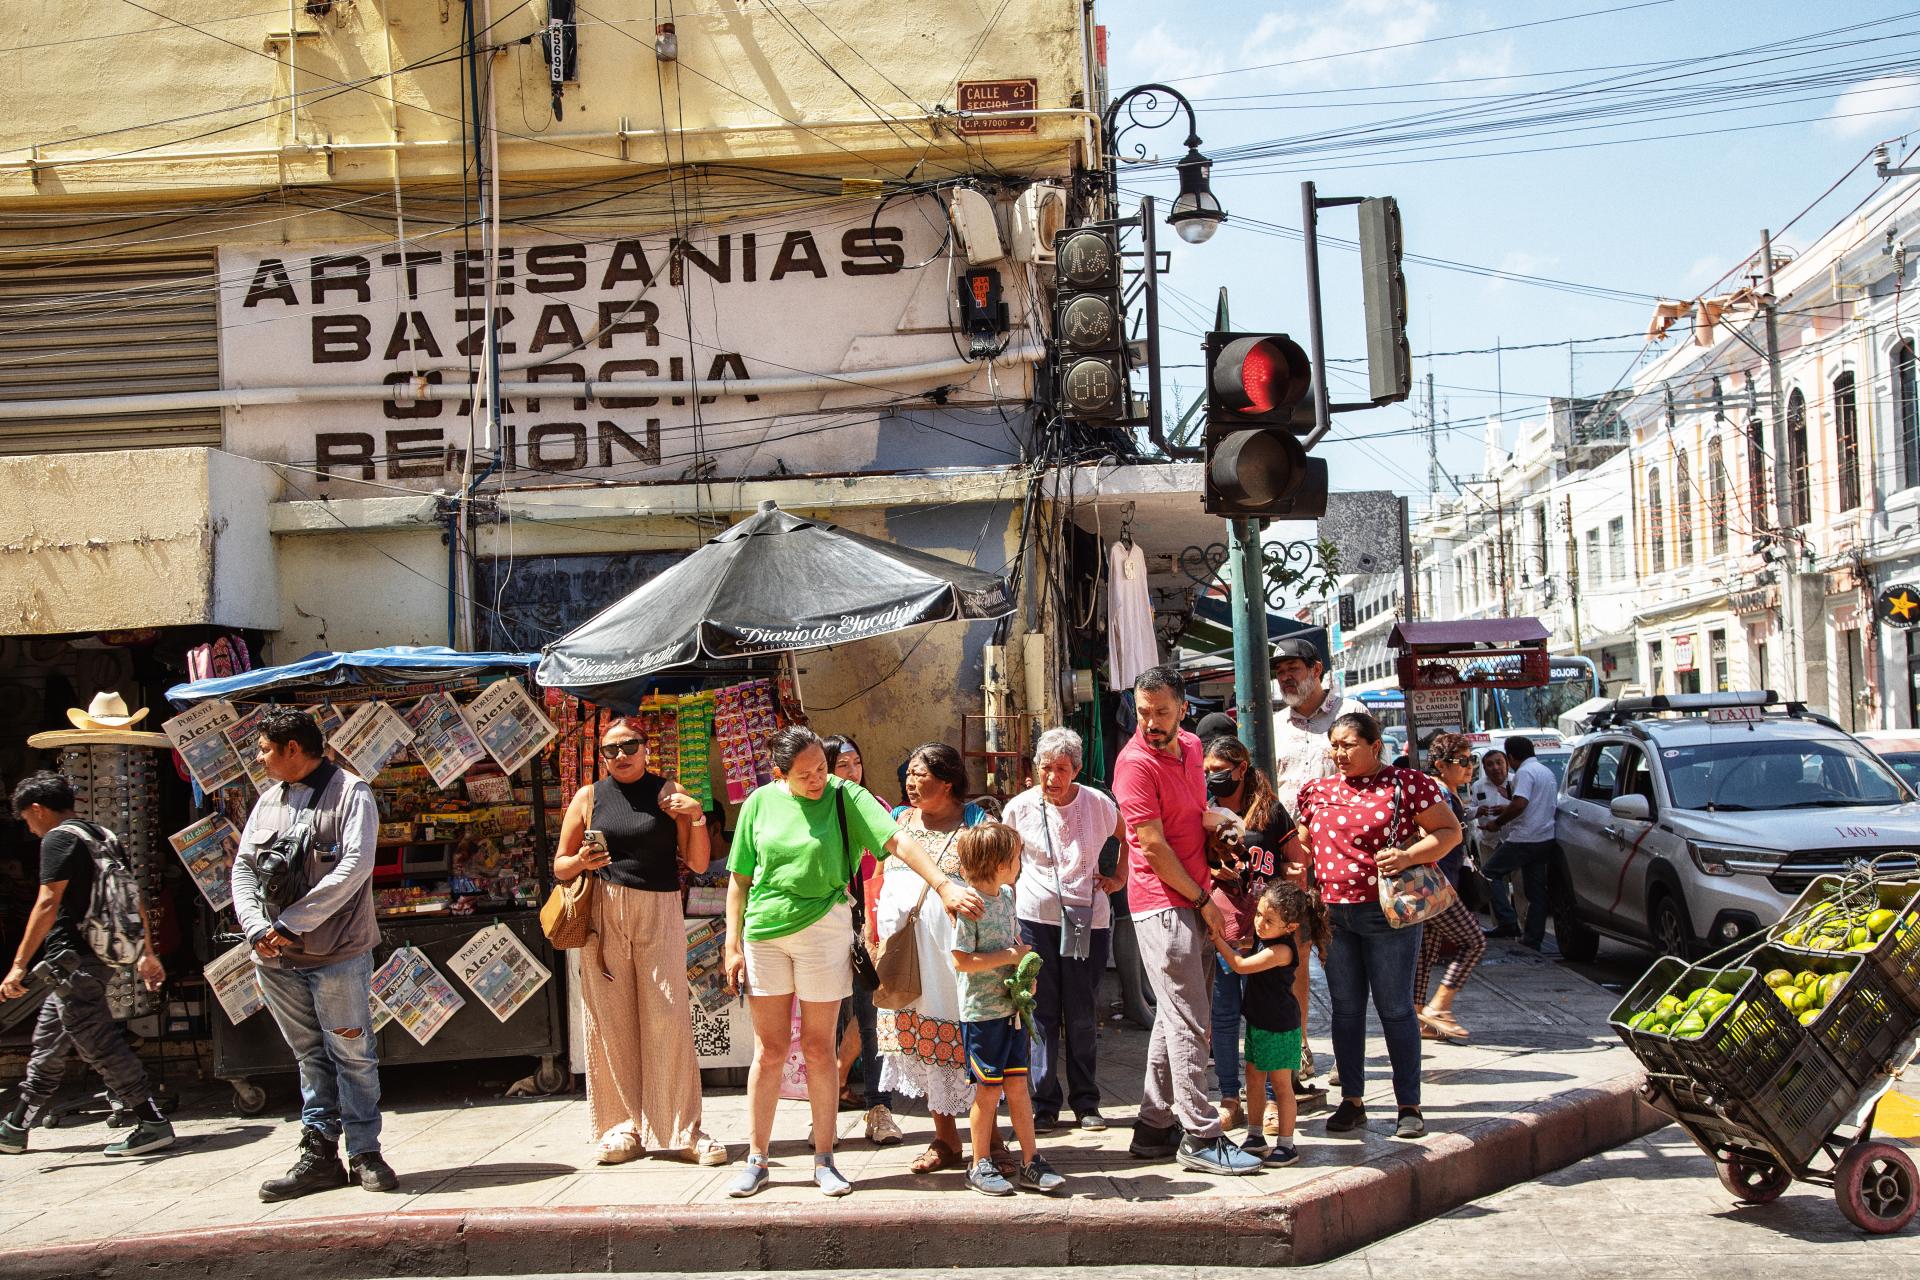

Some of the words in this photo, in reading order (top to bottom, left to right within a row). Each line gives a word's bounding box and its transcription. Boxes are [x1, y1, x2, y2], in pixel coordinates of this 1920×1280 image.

[967, 86, 1000, 100] CALLE
[1013, 85, 1026, 98] 65
[966, 100, 1009, 110] SECCION
[965, 120, 981, 128] C.P.
[982, 119, 1008, 128] 97000
[242, 226, 904, 308] ARTESANIAS
[312, 300, 660, 364] BAZAR
[735, 622, 809, 647] Diario
[811, 623, 836, 639] de
[837, 601, 929, 634] Yucatán
[475, 690, 520, 732] Alerta
[1426, 702, 1459, 710] CANDADO
[1714, 705, 1755, 721] TAXI
[178, 713, 230, 746] Alerta
[350, 744, 367, 762] Riesgo
[370, 724, 385, 740] marea
[382, 714, 394, 726] roja
[1835, 825, 1879, 839] 1404
[463, 934, 509, 980] Alerta
[219, 984, 238, 998] Riesgo
